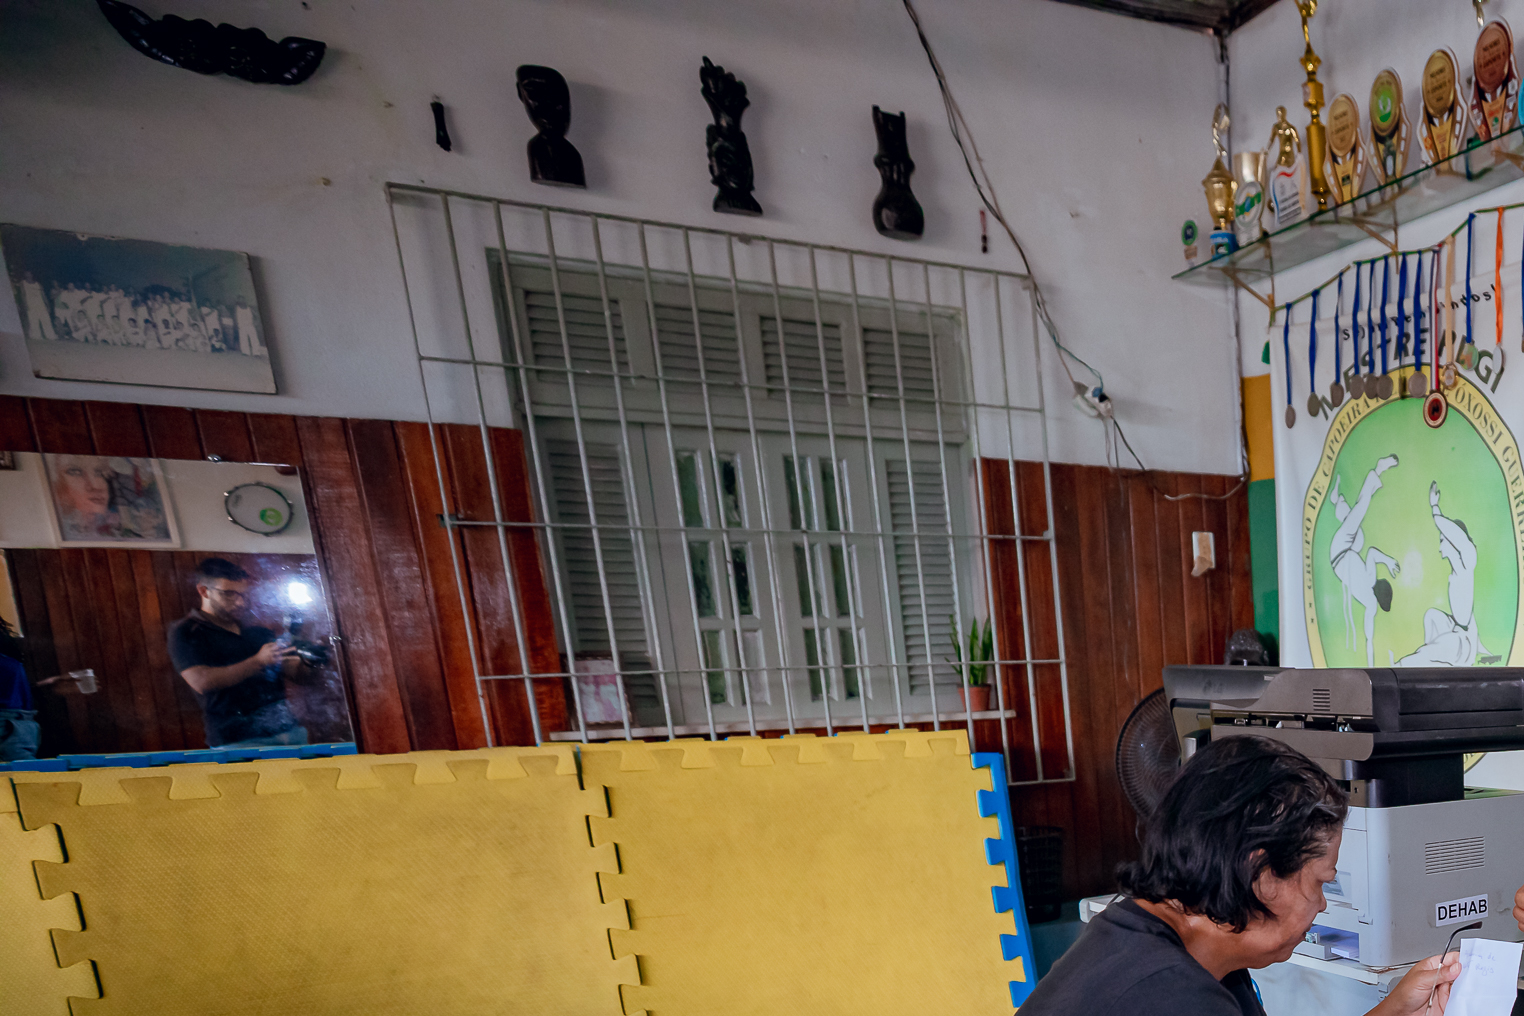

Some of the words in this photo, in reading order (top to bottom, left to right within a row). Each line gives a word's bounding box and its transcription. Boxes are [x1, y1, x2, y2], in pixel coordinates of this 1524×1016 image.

[1454, 382, 1504, 445] ÓXOSSI
[1307, 481, 1325, 510] DE
[1322, 396, 1371, 477] CAPOEIRA
[1438, 898, 1488, 921] DEHAB
